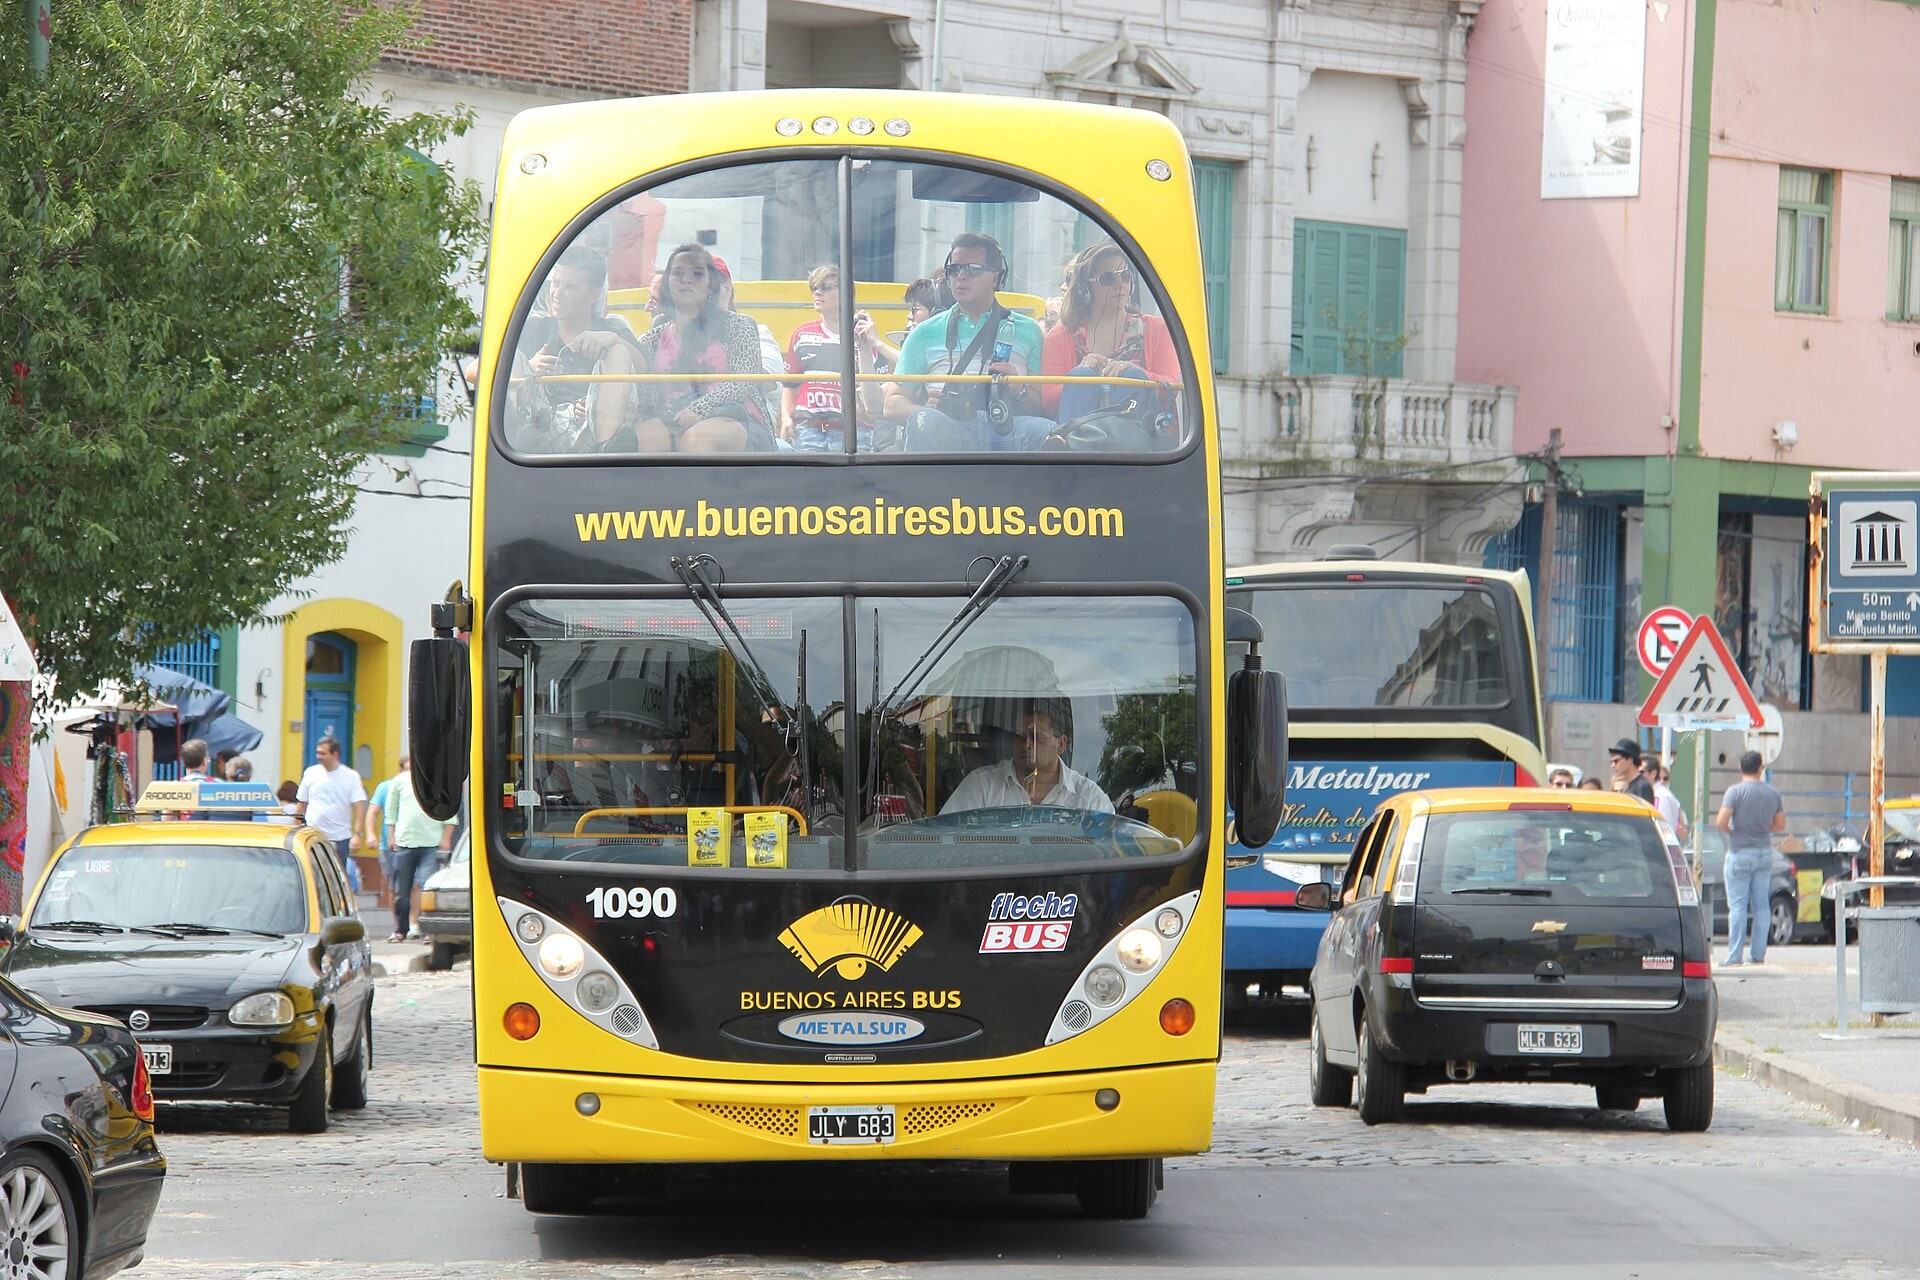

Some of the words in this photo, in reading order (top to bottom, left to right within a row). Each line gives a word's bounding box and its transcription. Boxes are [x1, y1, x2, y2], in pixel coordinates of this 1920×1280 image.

[575, 498, 1125, 541] www.buenosairesbus.com
[1846, 610, 1877, 621] Museo
[1880, 610, 1911, 621] Benito
[1838, 623, 1886, 636] Quinquela
[1888, 623, 1917, 635] Martín
[1286, 766, 1430, 795] Metalpar
[215, 791, 272, 801] PAMPA
[1281, 803, 1338, 828] Vuelta
[1344, 807, 1367, 828] de
[85, 860, 111, 872] LIBRE
[585, 887, 677, 918] 1090
[988, 892, 1078, 920] flecha
[984, 925, 1067, 949] BUS
[740, 991, 837, 1010] BUENOS
[843, 991, 906, 1009] AIRES
[912, 990, 962, 1009] BUS
[795, 1021, 907, 1036] METALSUR
[1520, 1031, 1546, 1047] MLR
[1554, 1031, 1579, 1048] 633
[812, 1116, 846, 1137] JLY
[858, 1115, 892, 1136] 683
